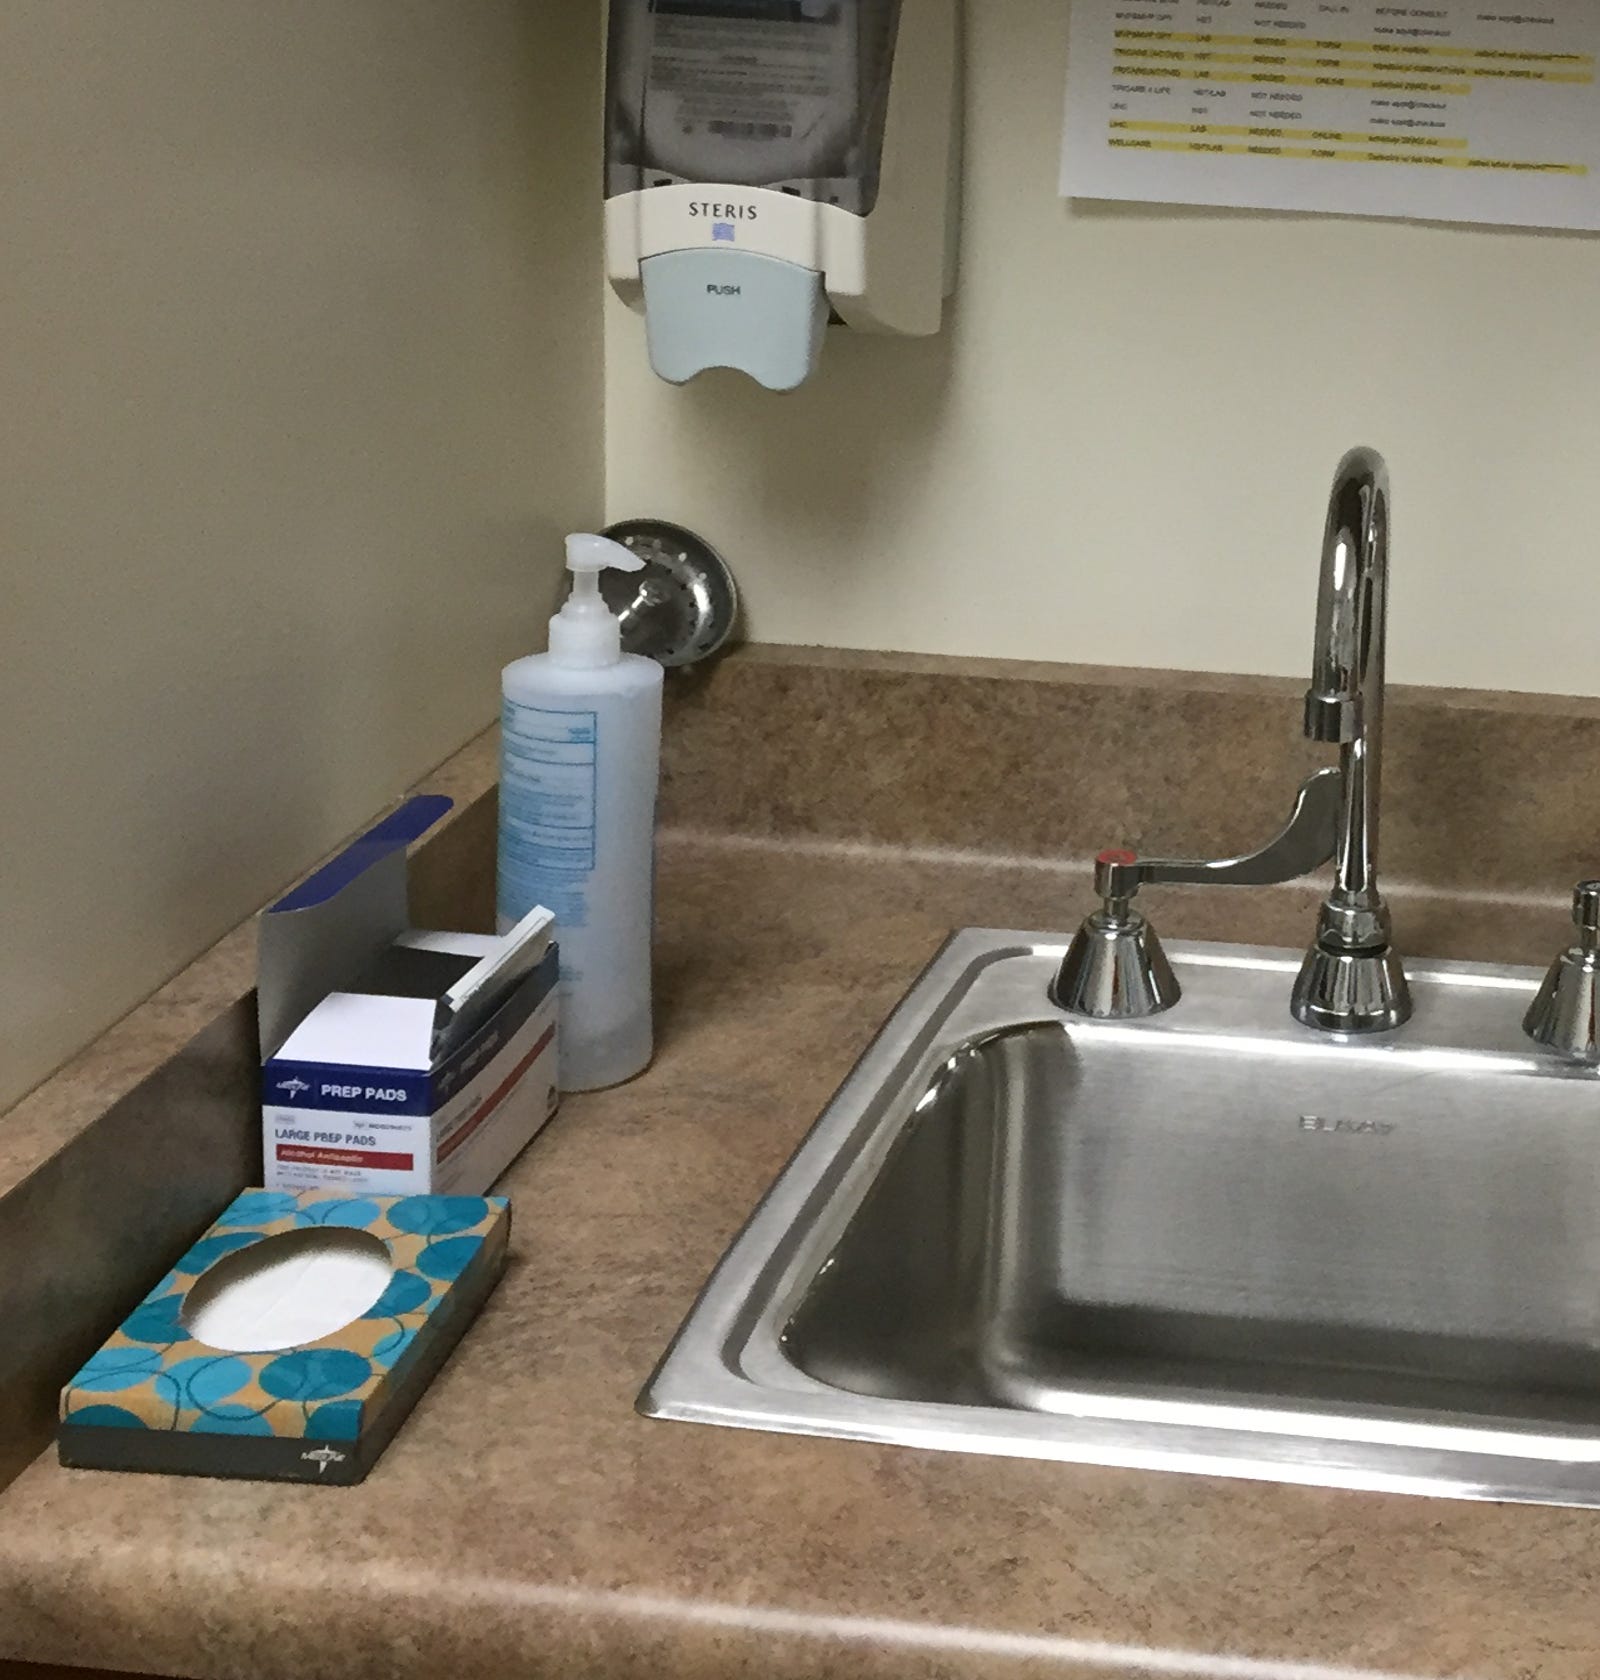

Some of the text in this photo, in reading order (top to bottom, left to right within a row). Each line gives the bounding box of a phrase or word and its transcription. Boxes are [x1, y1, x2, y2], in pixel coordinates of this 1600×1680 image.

[688, 202, 758, 220] STERIS
[706, 284, 741, 295] PUSH
[321, 1084, 362, 1099] PREP
[365, 1087, 407, 1102] PADS
[274, 1128, 376, 1146] LARGE PREP PADS
